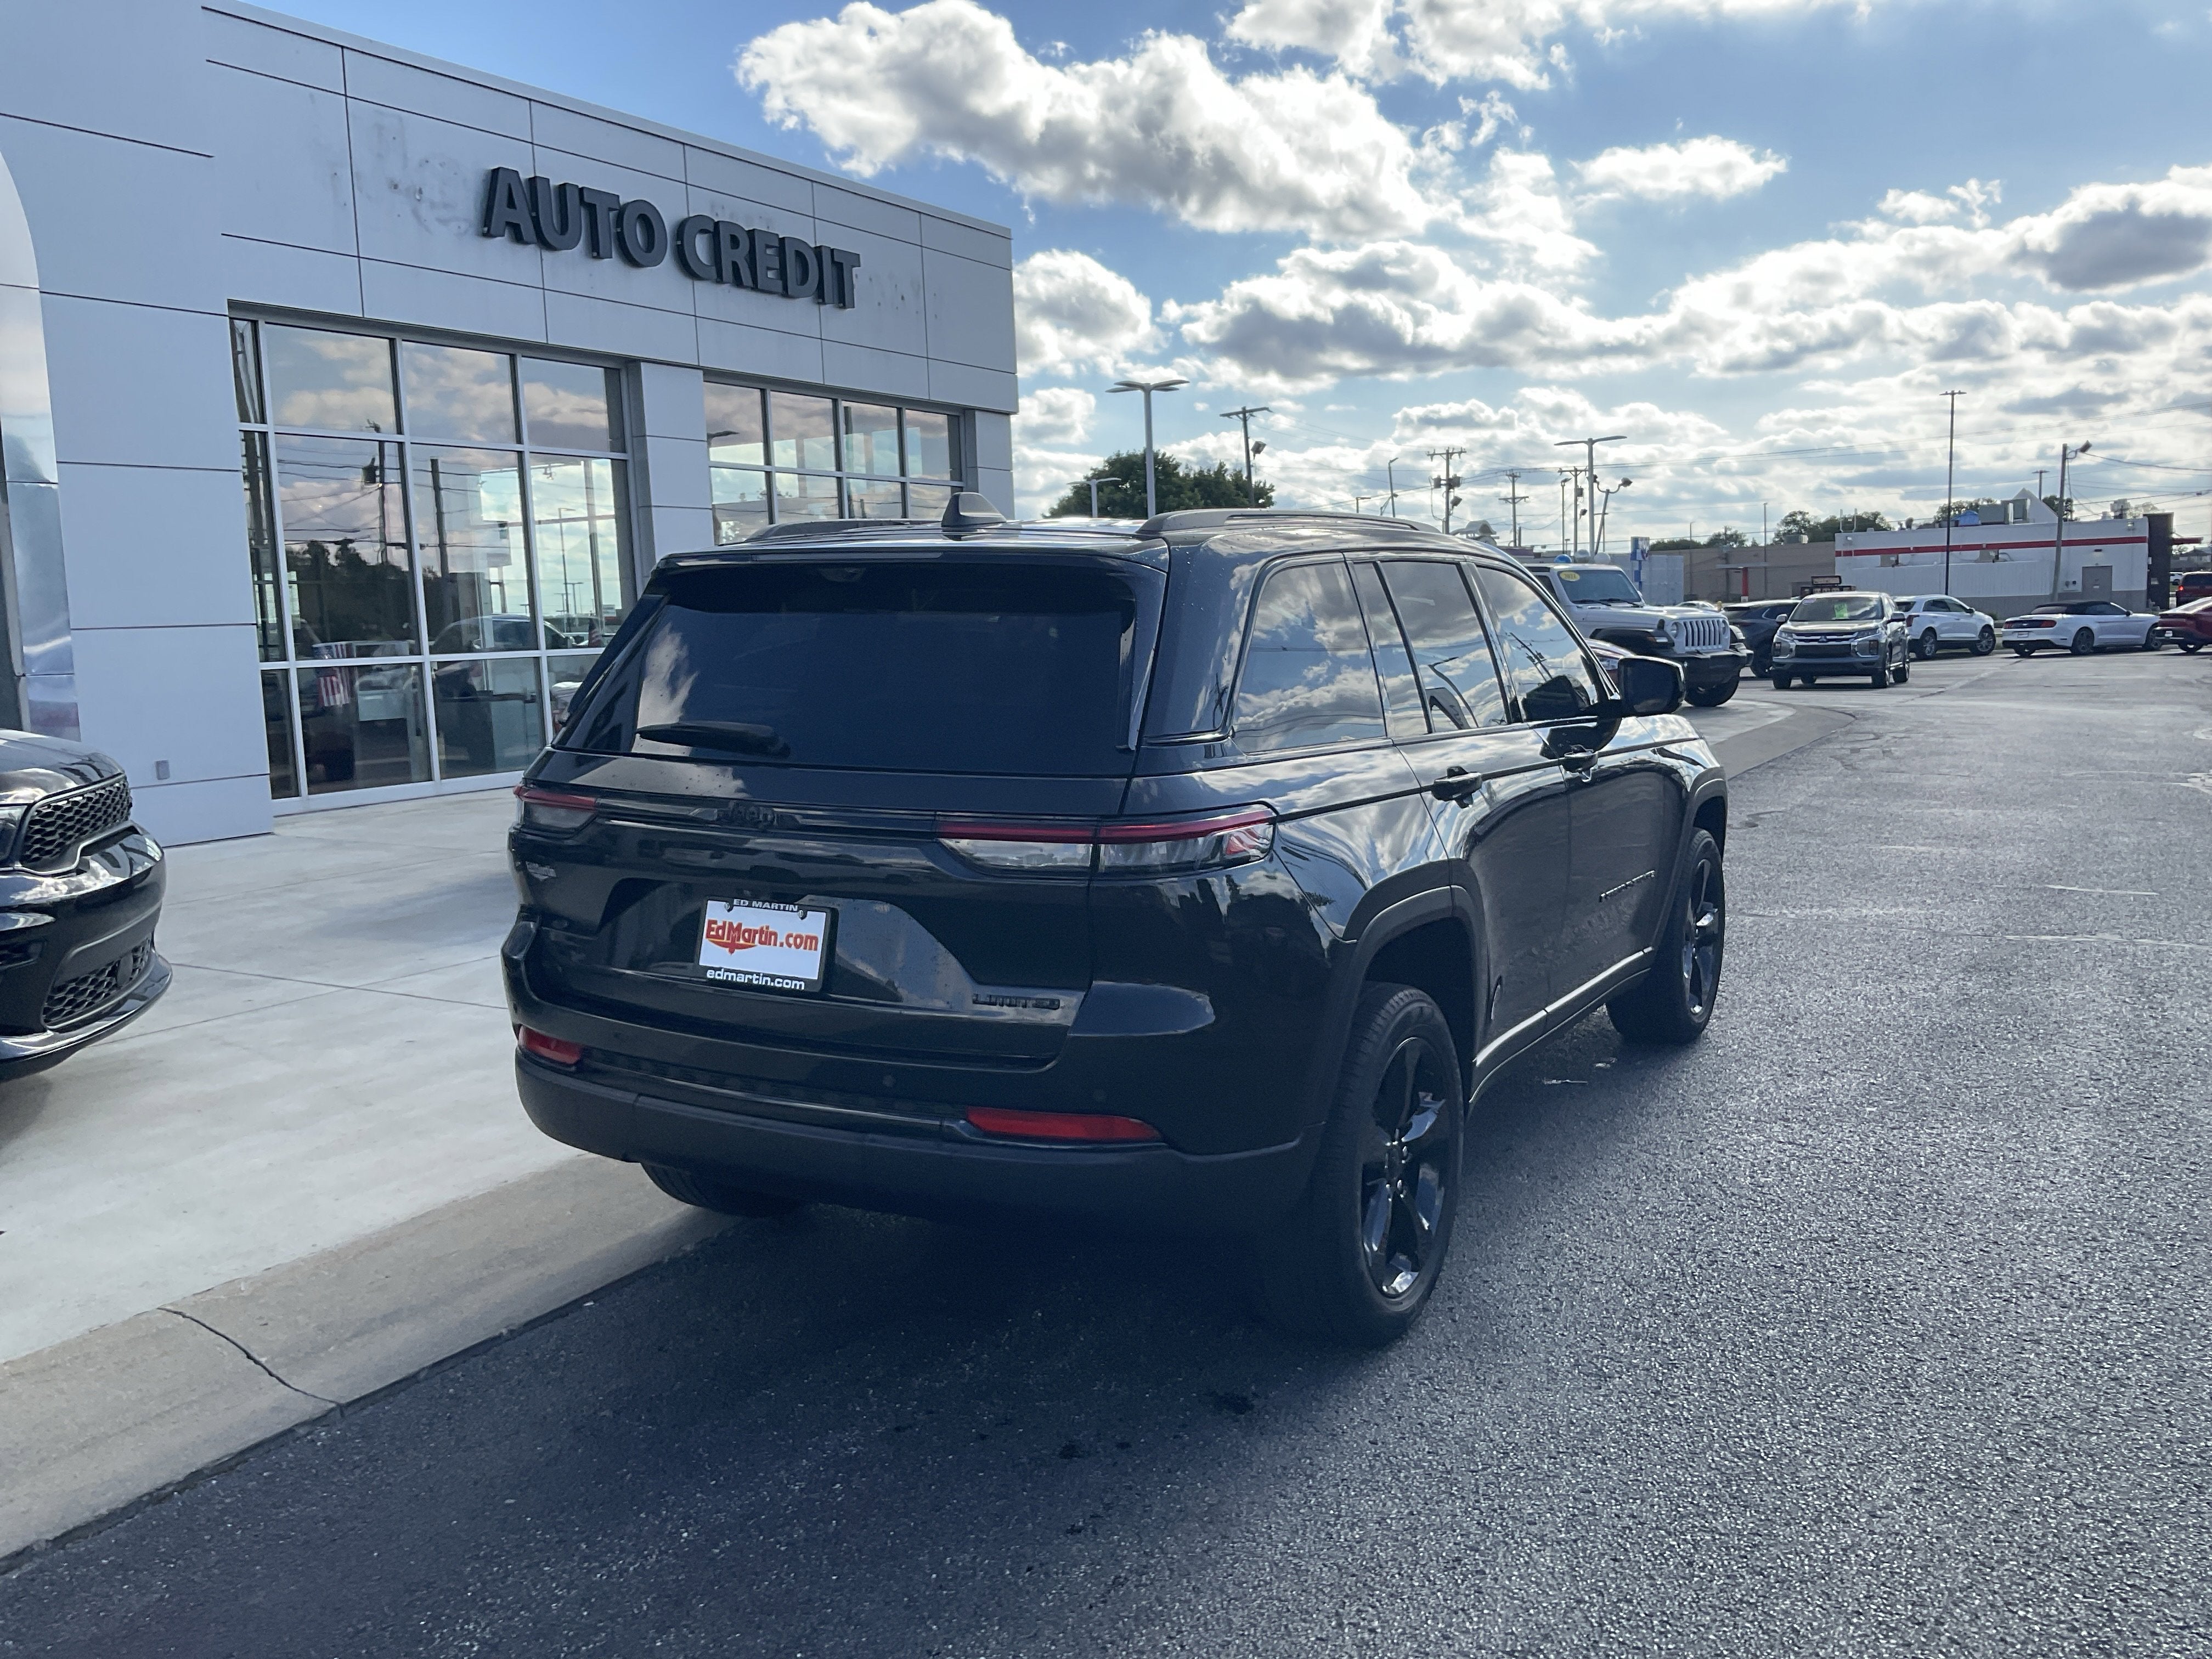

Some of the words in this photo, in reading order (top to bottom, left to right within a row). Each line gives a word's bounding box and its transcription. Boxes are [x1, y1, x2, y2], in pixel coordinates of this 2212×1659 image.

[483, 166, 667, 268] AUTO
[676, 215, 860, 309] CREDIT
[752, 900, 799, 912] MARTIN
[706, 968, 805, 990] edmartin.com
